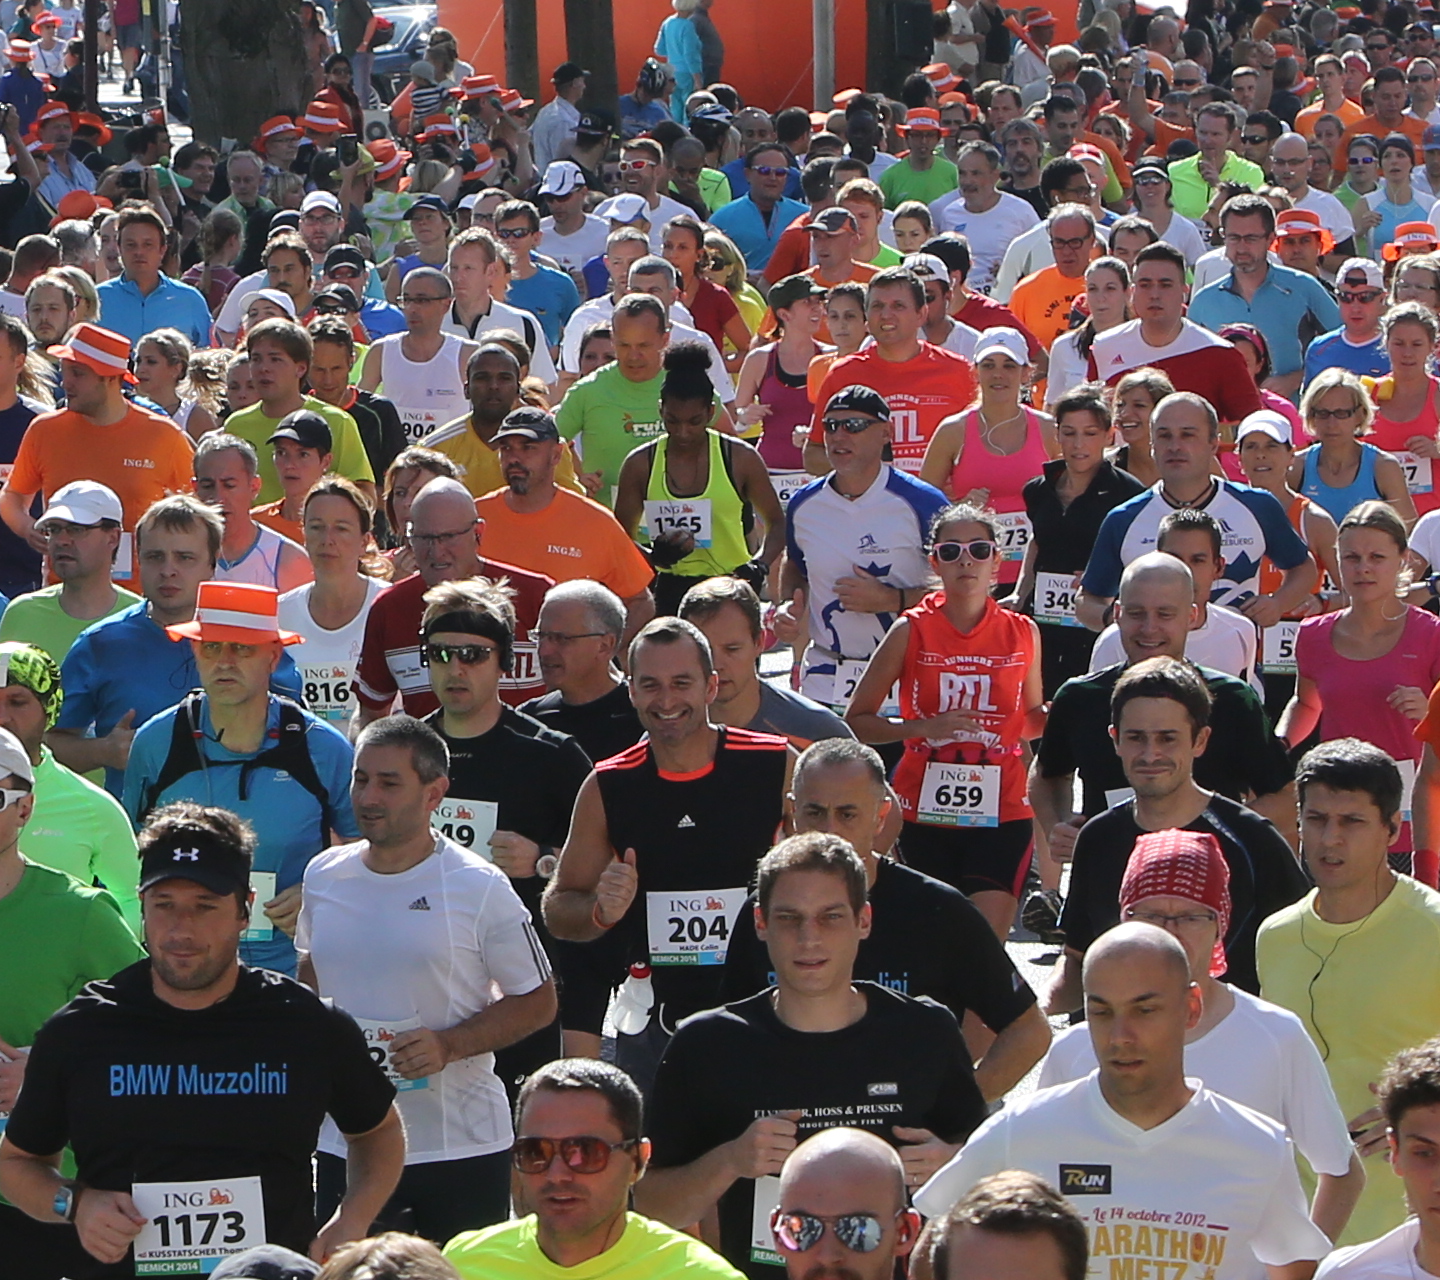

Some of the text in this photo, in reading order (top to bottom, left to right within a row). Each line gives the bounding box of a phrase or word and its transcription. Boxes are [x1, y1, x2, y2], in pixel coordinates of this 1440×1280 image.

[403, 413, 421, 422] ING
[123, 458, 141, 467] ING
[781, 479, 799, 487] ING
[659, 505, 679, 514] ING
[547, 545, 567, 555] ING
[1048, 578, 1069, 588] ING
[944, 655, 993, 667] RUNNERS
[304, 667, 330, 679] ING
[306, 681, 350, 704] 816
[938, 671, 998, 712] RTL
[939, 768, 967, 781] ING
[935, 784, 984, 807] 659
[669, 899, 702, 913] ING
[667, 915, 729, 942] 204
[652, 954, 697, 963] REMICH 2014
[110, 1062, 288, 1096] BMW Muzzolini
[815, 1104, 903, 1117] HOSS PRUSSEN
[1067, 1170, 1105, 1188] RUN
[163, 1191, 204, 1208] ING
[1092, 1207, 1206, 1228] Le 14 octobre 2012
[153, 1211, 246, 1246] 1173
[1092, 1223, 1226, 1266] ARATHON
[148, 1248, 217, 1258] KUSSTATSCHER
[137, 1261, 199, 1272] REMICH 2014
